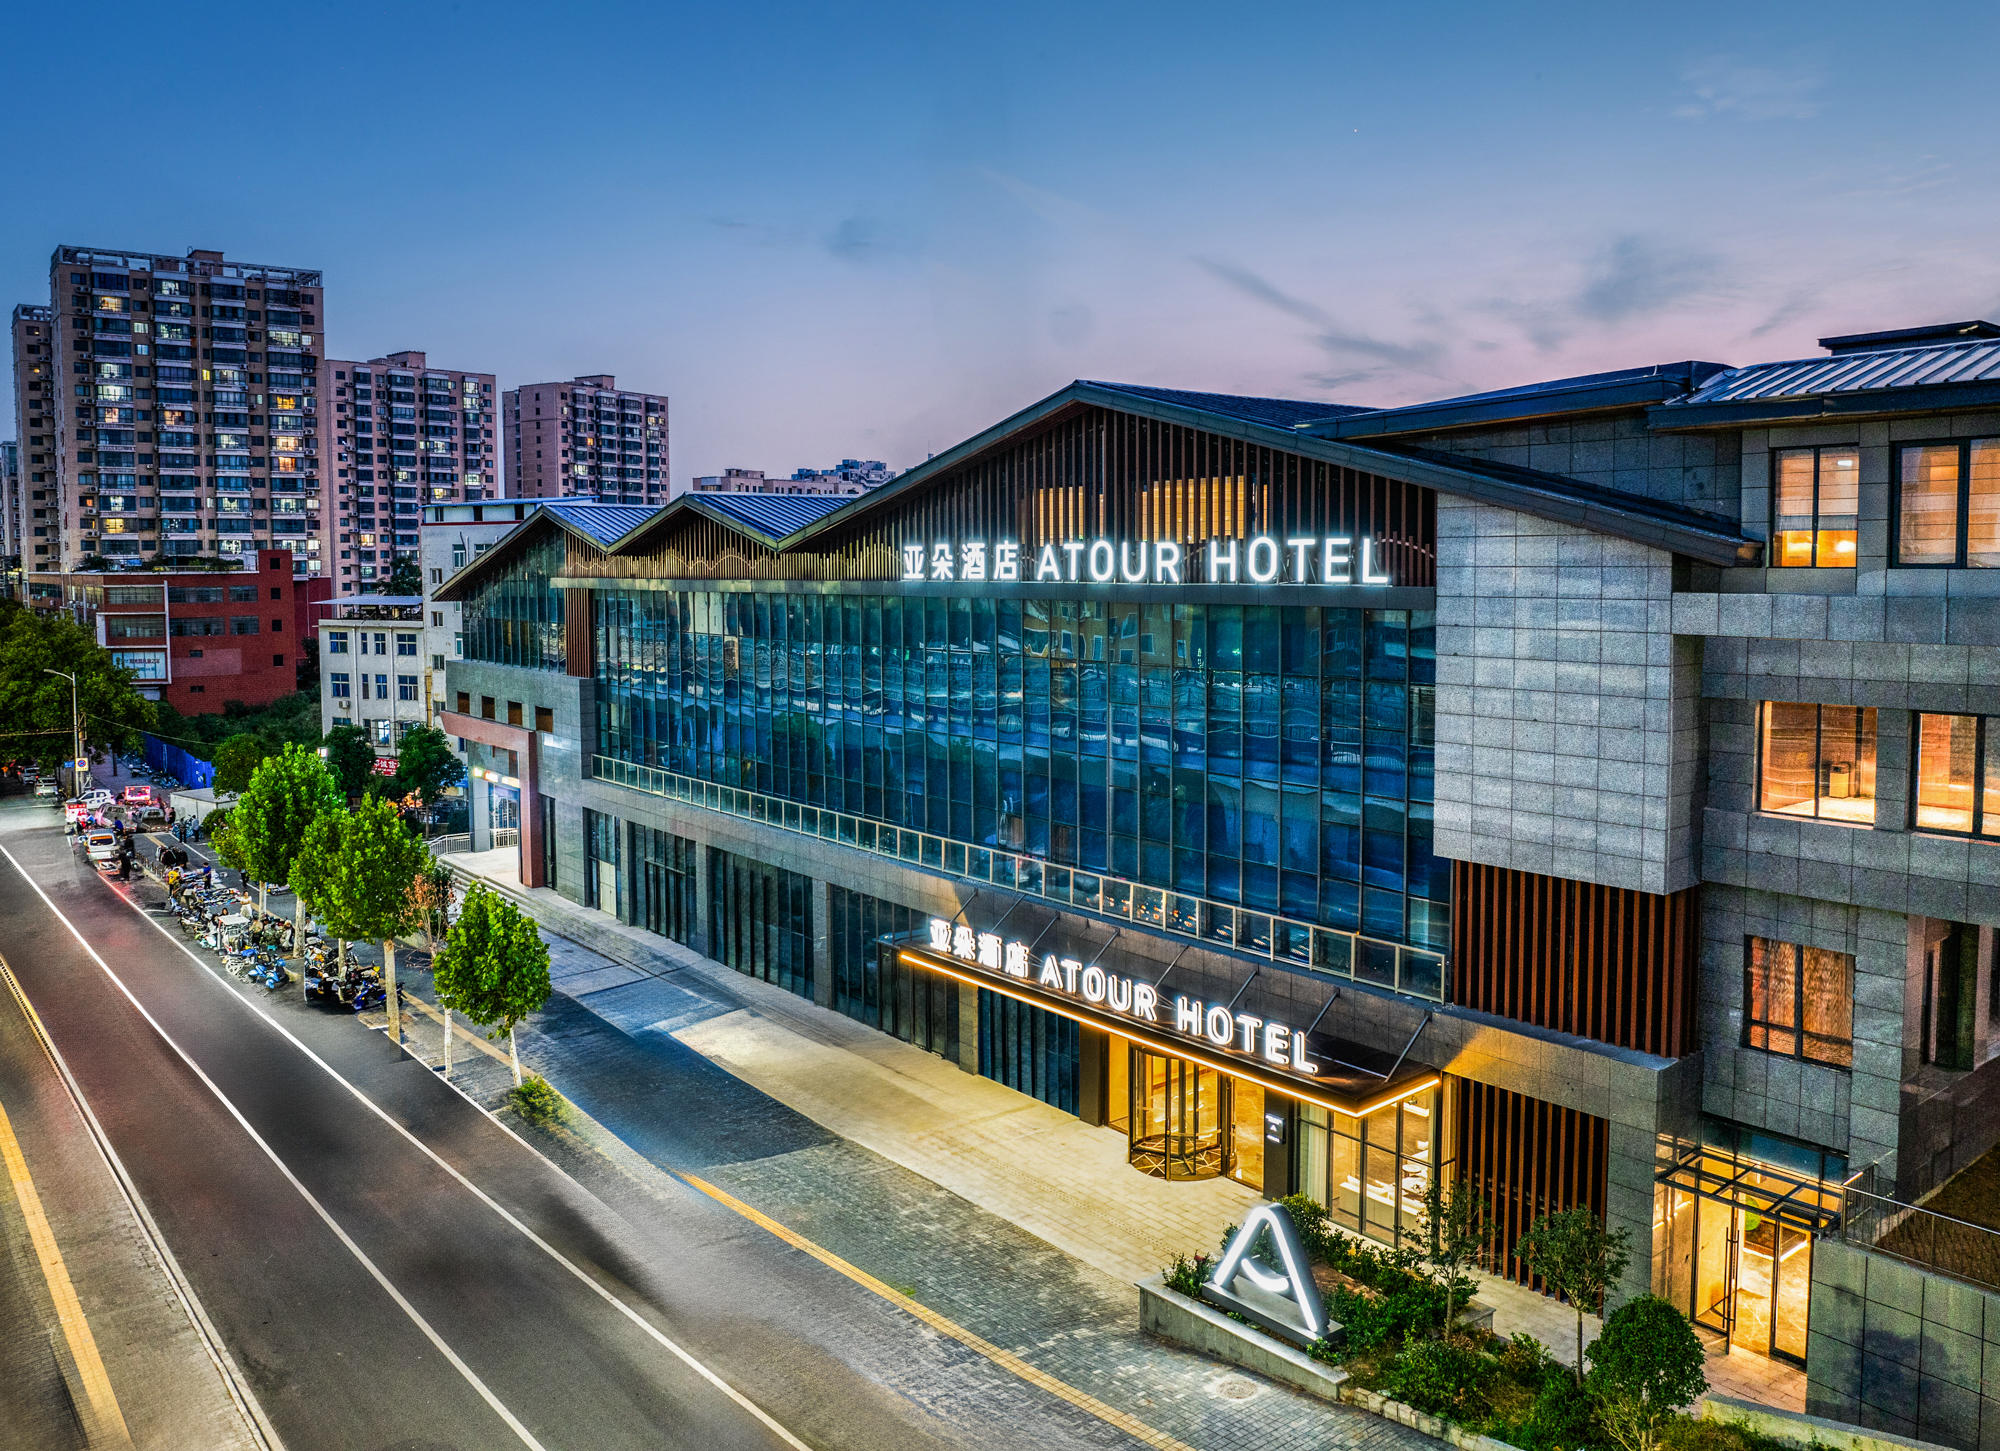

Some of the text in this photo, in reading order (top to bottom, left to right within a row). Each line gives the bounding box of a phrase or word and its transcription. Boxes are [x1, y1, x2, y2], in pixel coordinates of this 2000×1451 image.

[903, 536, 1389, 584] 亚朵酒店 ATOUR HOTEL
[929, 918, 1319, 1074] 亚朵酒店 ATOUR HOTEL
